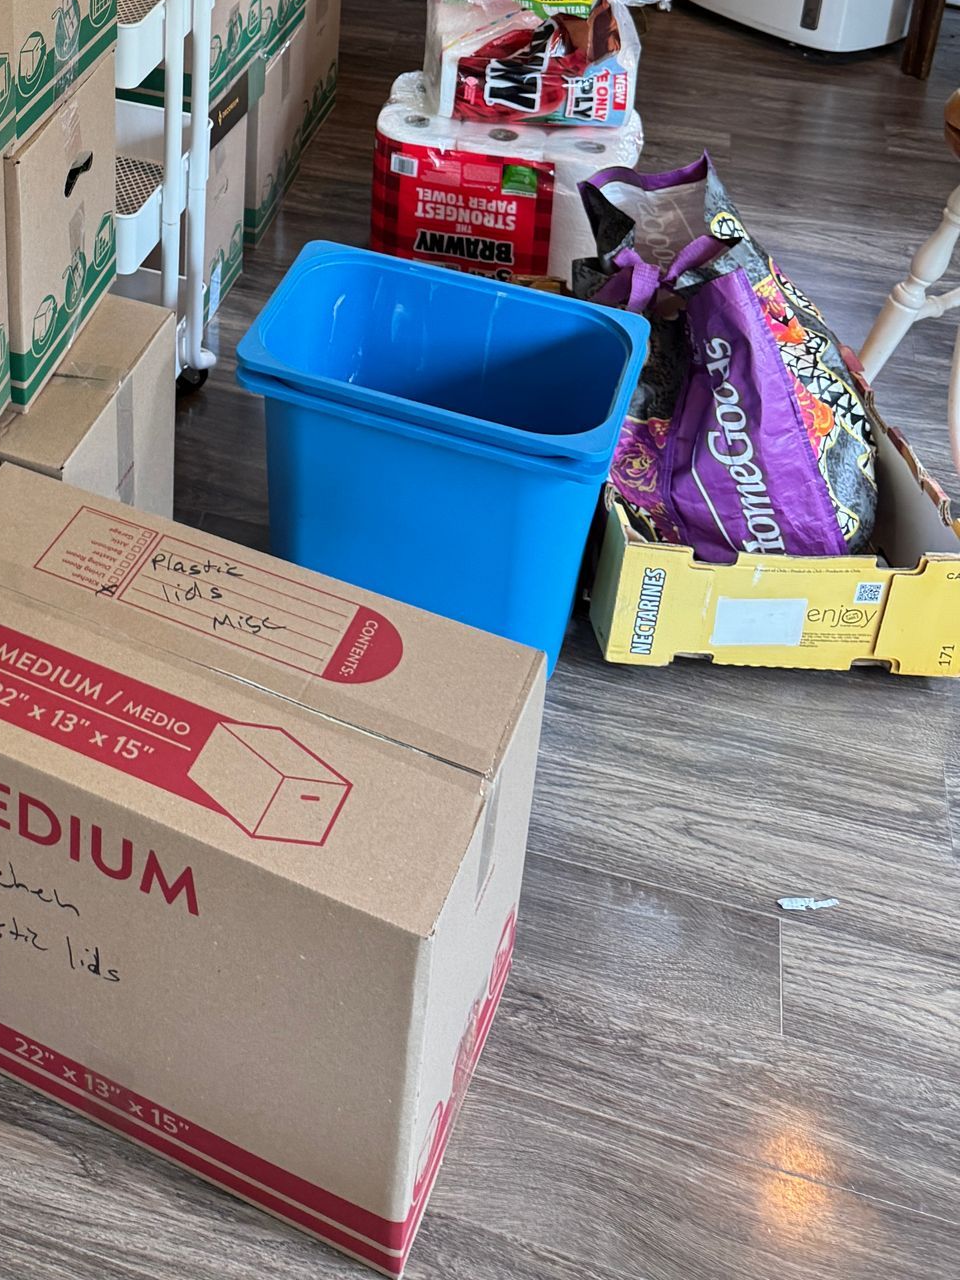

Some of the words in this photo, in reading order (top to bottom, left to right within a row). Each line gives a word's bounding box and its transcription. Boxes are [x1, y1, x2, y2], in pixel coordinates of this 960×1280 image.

[415, 187, 465, 206] TOWEL
[468, 196, 518, 215] PAPER
[414, 201, 517, 231] STRONGEST
[456, 223, 473, 234] THE
[415, 230, 513, 264] BRAWNY
[162, 581, 224, 603] lids
[630, 567, 667, 655] NECTARINES
[806, 604, 878, 628] enjoy
[337, 619, 380, 677] CONTENTS:
[938, 644, 955, 667] 171
[27, 704, 51, 721] x
[51, 708, 91, 734] 13"
[88, 730, 110, 748] x
[111, 734, 155, 761] 15"
[121, 700, 192, 738] MEDIO
[66, 936, 121, 983] lids
[14, 1037, 55, 1066] 22"
[62, 1064, 78, 1083] x
[84, 1072, 121, 1099] 13"
[128, 1099, 144, 1118] x
[151, 1108, 190, 1135] 15"
